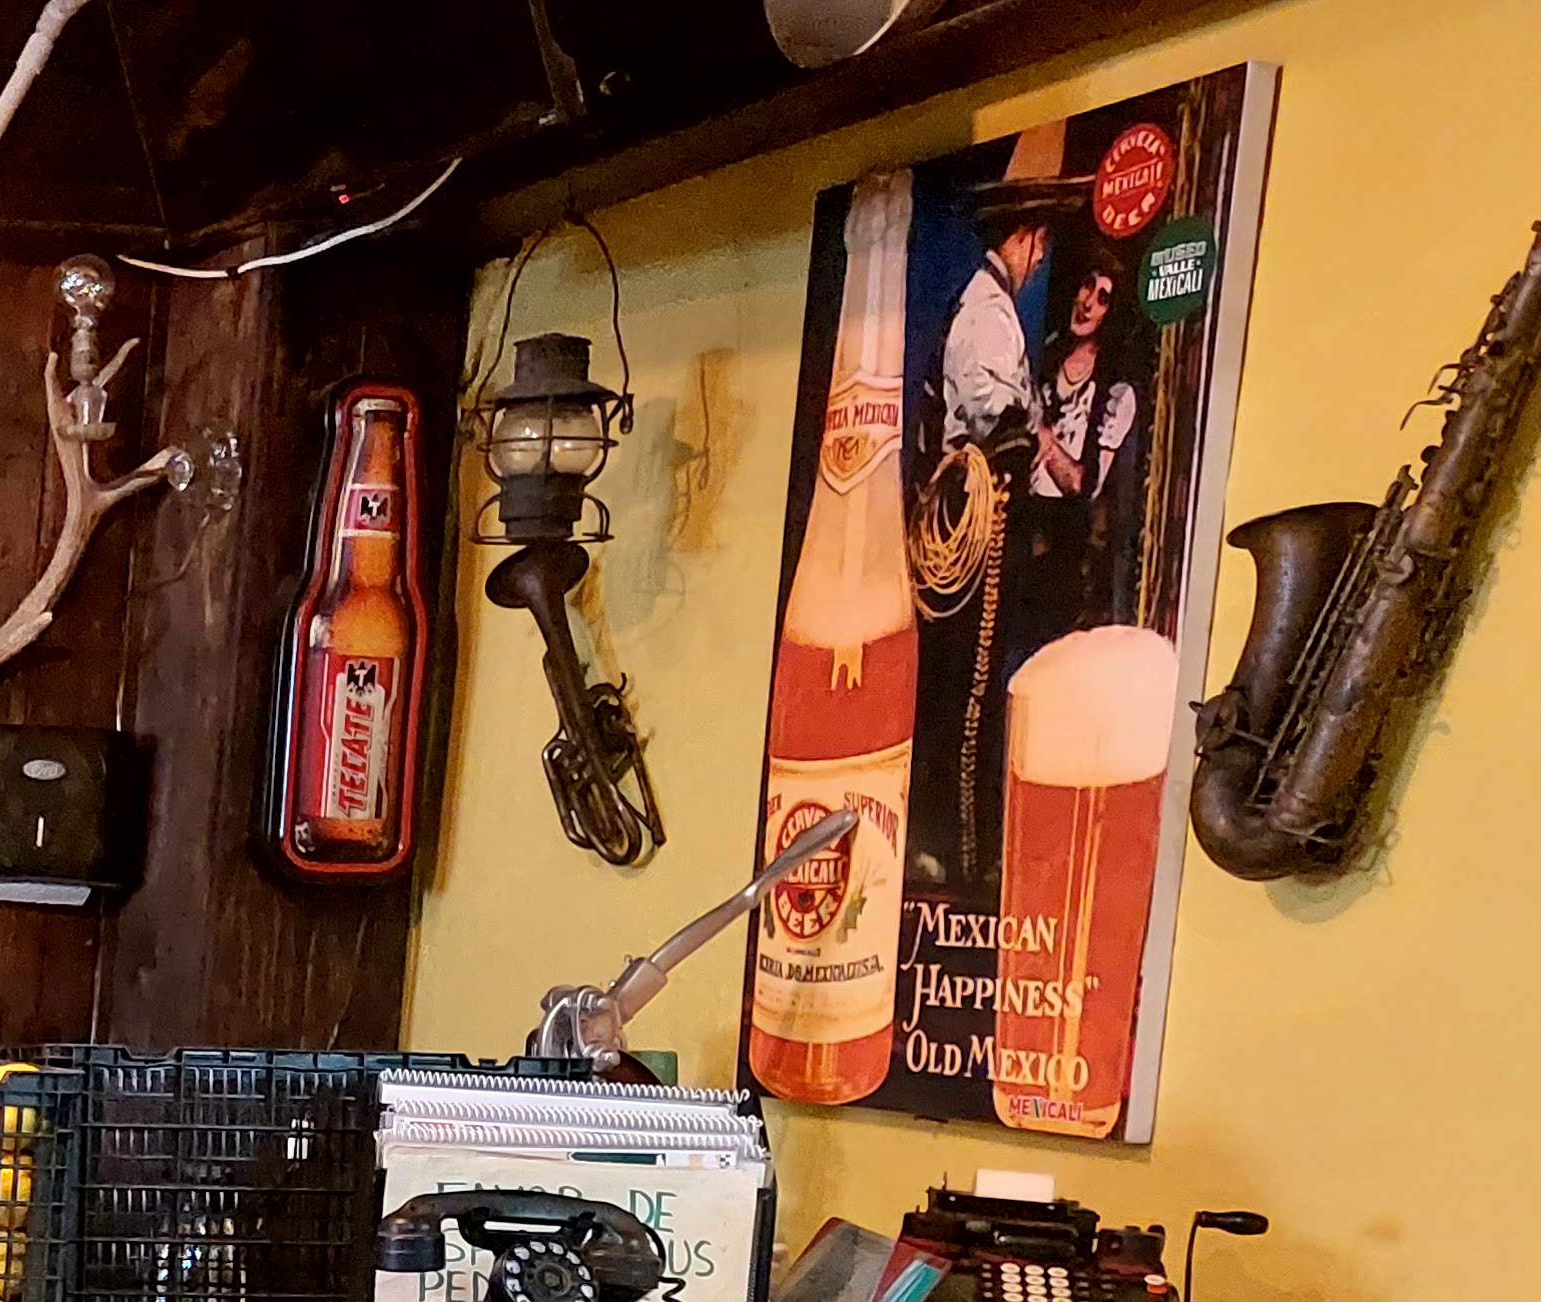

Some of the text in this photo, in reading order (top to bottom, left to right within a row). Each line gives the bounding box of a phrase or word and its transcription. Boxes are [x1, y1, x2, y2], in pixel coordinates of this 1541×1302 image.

[1150, 241, 1207, 267] MUSEO
[337, 696, 375, 818] TECATE
[906, 1029, 1090, 1092] OLD MEXICO
[628, 1189, 678, 1234] DE
[666, 1239, 715, 1277] US
